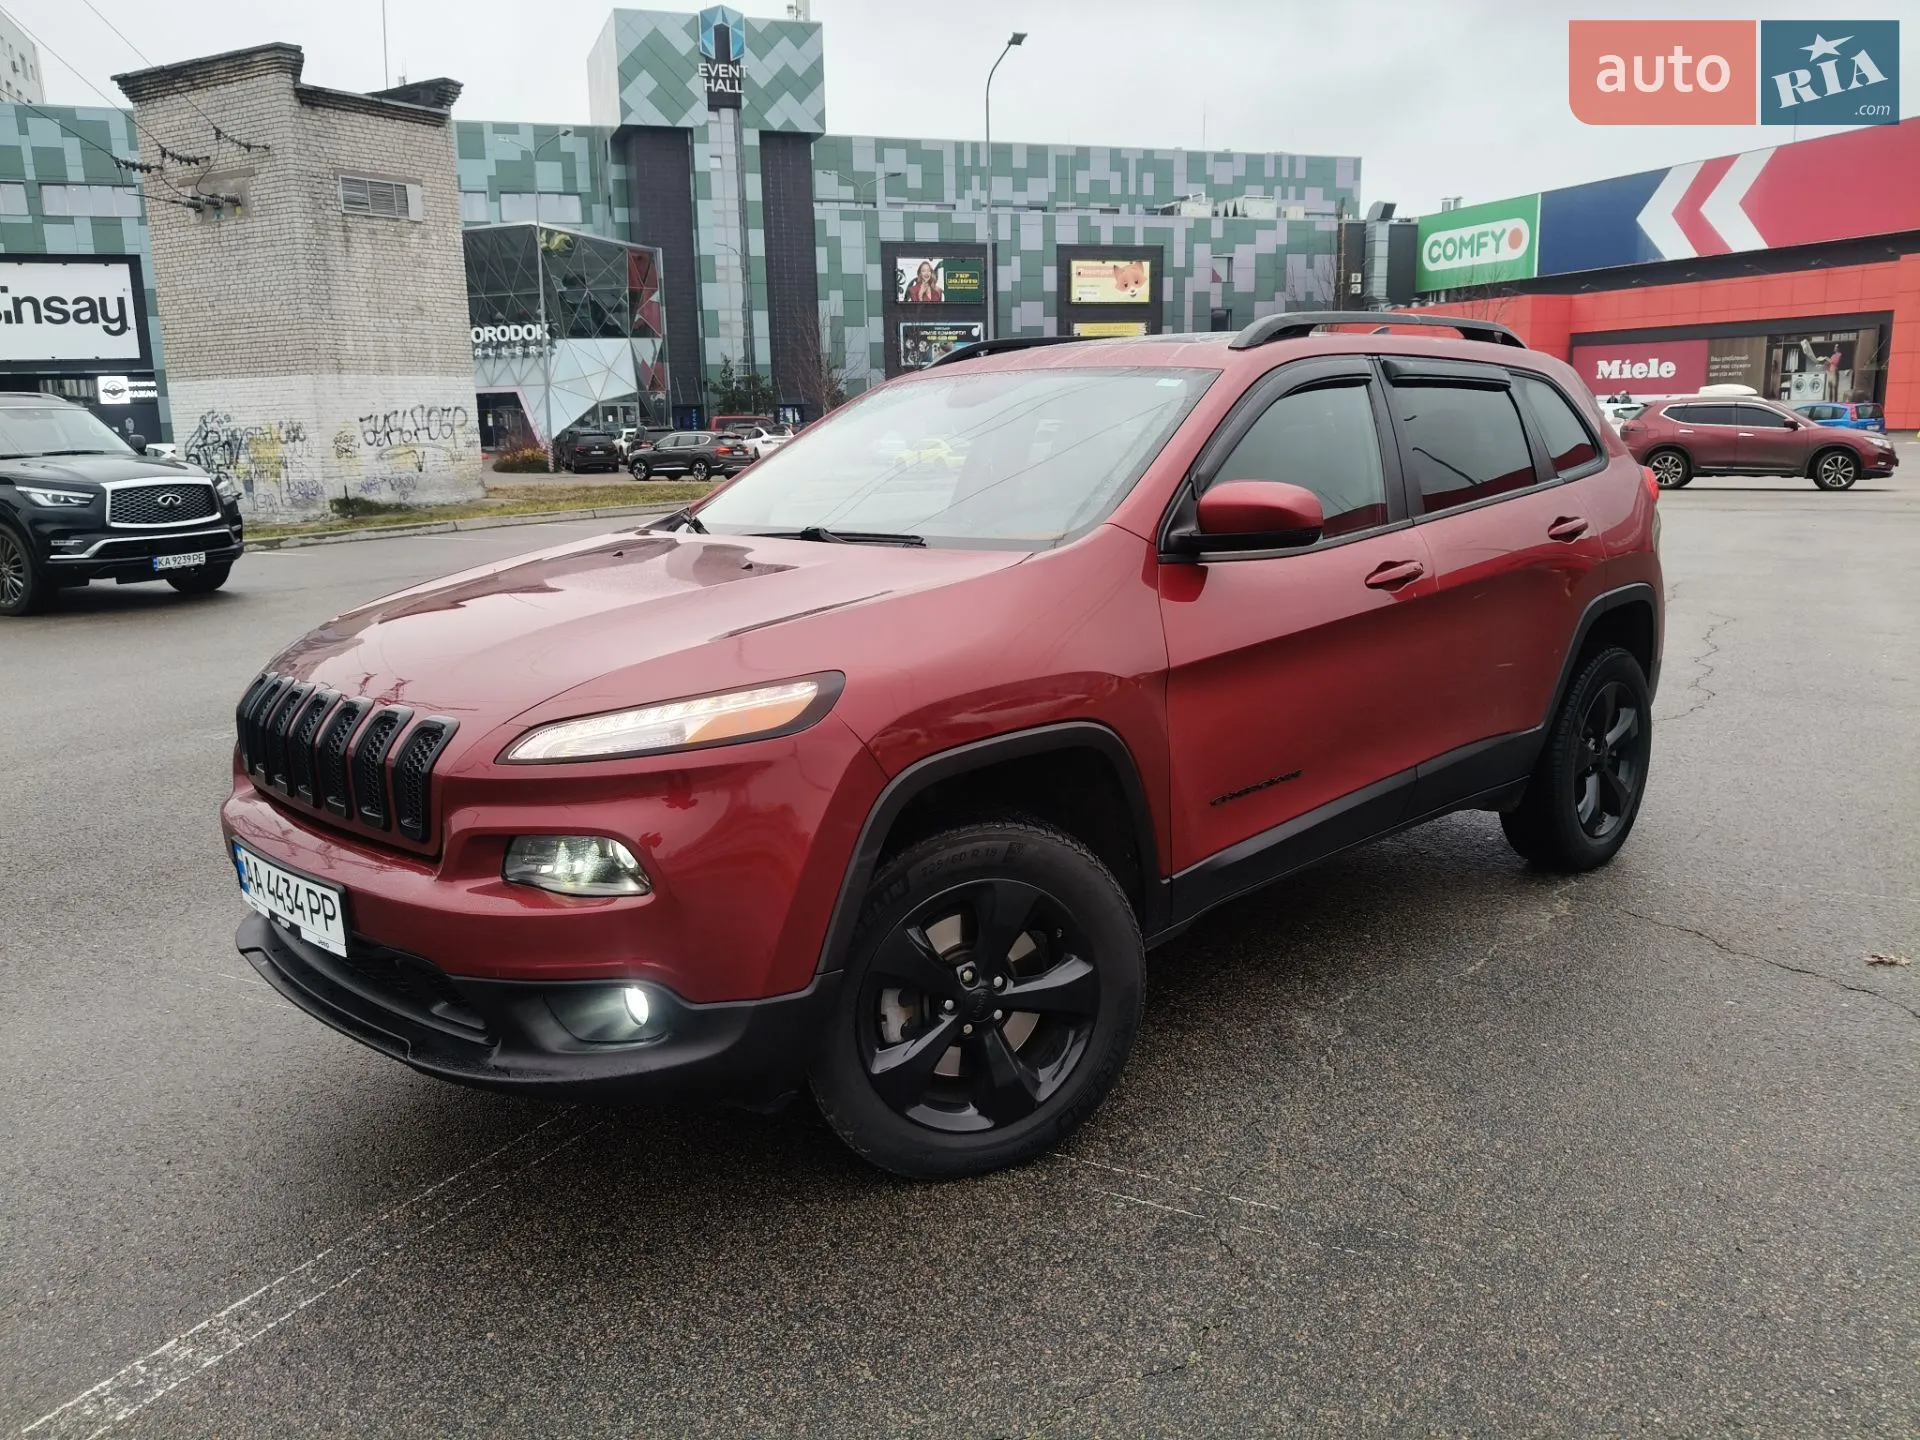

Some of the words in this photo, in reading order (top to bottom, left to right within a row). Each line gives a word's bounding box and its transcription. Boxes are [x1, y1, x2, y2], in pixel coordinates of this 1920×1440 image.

[697, 63, 749, 78] EVENT
[703, 78, 745, 93] HALL
[1427, 228, 1507, 264] COMFY
[0, 285, 129, 337] insay
[470, 323, 551, 344] ORODOK
[1595, 357, 1677, 380] Miele
[245, 856, 266, 899] AA
[267, 870, 306, 922] 4434
[306, 887, 337, 932] PP
